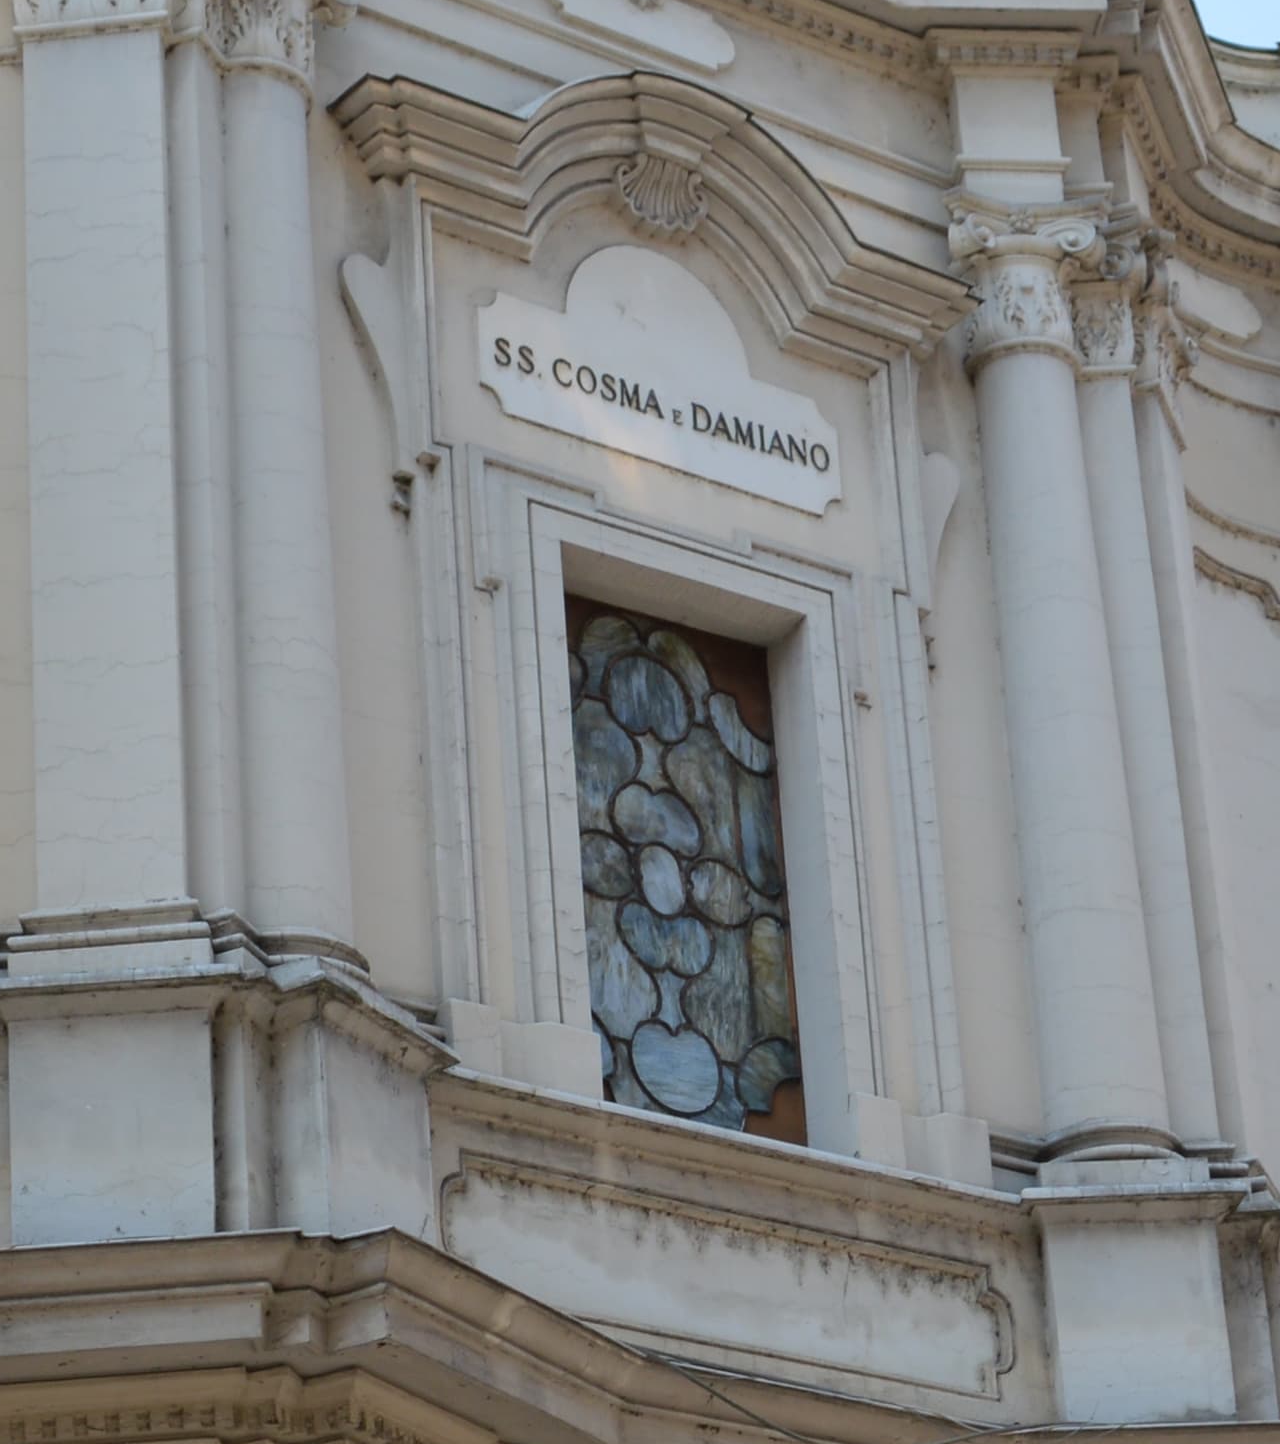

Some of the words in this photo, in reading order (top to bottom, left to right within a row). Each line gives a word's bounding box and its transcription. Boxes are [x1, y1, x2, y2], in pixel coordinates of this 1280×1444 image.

[493, 336, 543, 378] SS.
[552, 358, 664, 420] COSMA
[672, 408, 684, 426] E
[691, 402, 831, 472] DAMIANO
